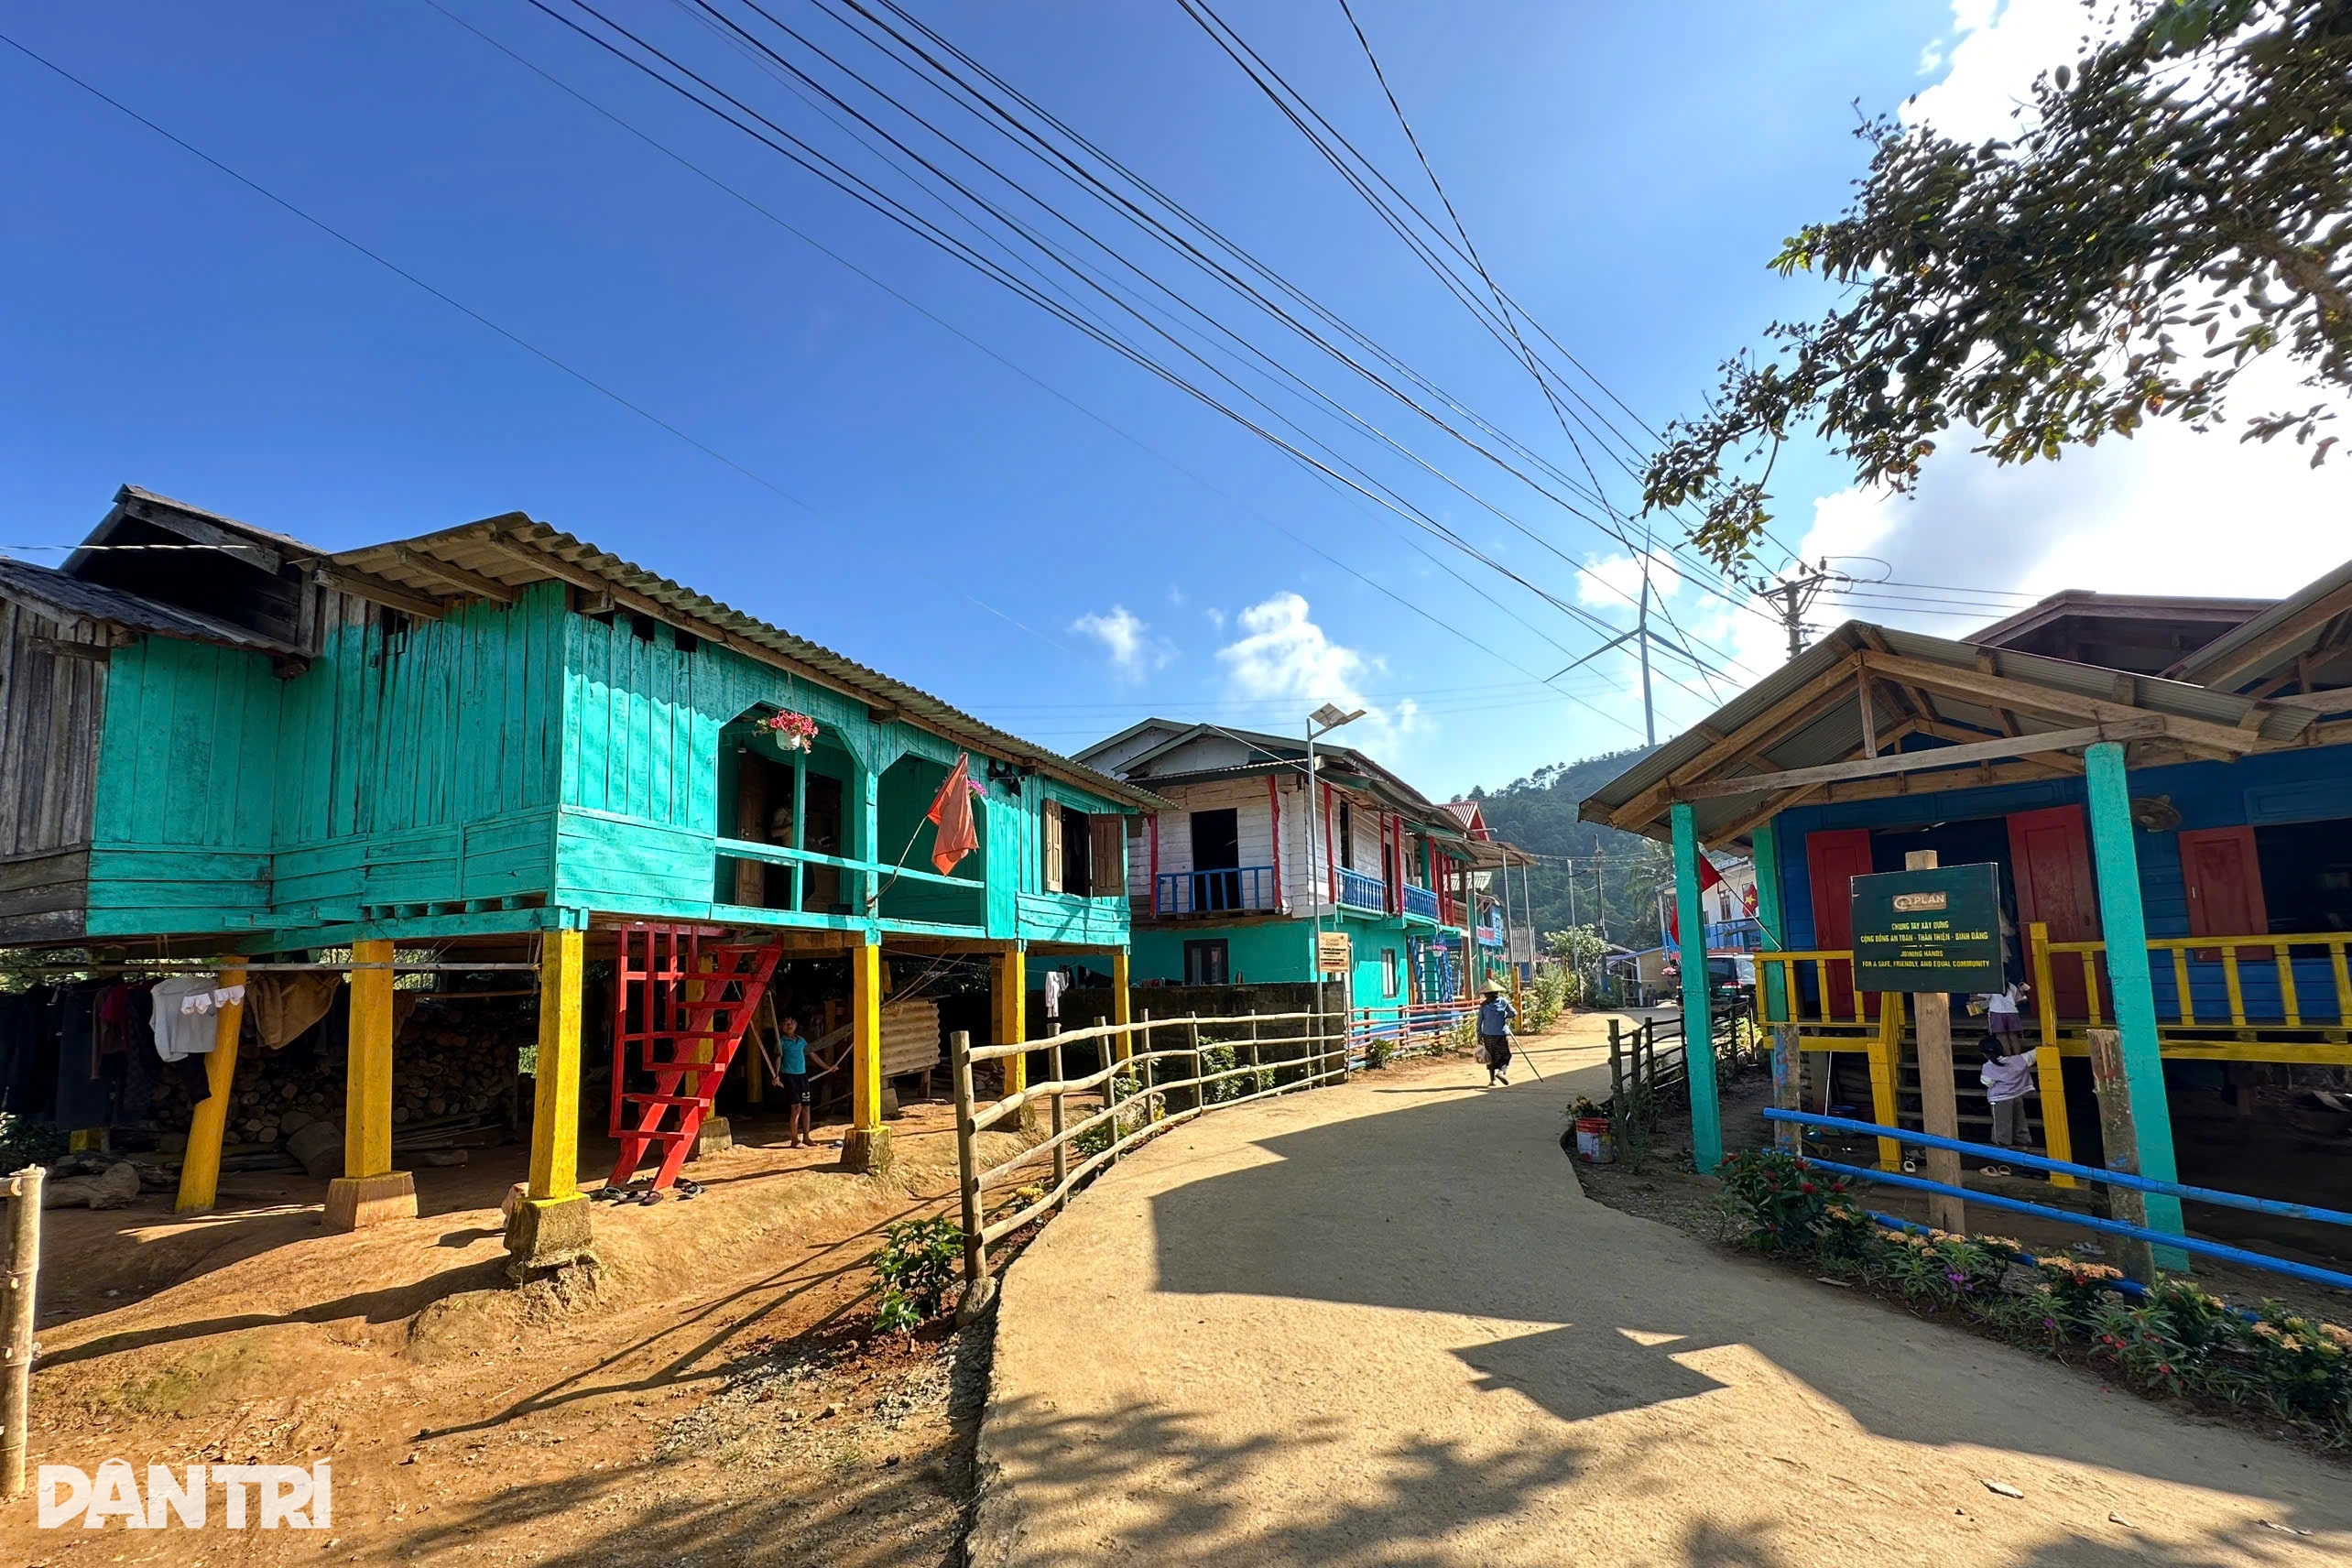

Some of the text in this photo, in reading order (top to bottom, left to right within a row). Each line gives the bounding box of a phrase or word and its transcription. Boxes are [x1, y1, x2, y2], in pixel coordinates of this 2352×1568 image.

[1914, 894, 1944, 905] PLAN
[1891, 922, 1910, 931] CHUNG
[1890, 934, 1899, 942] AN
